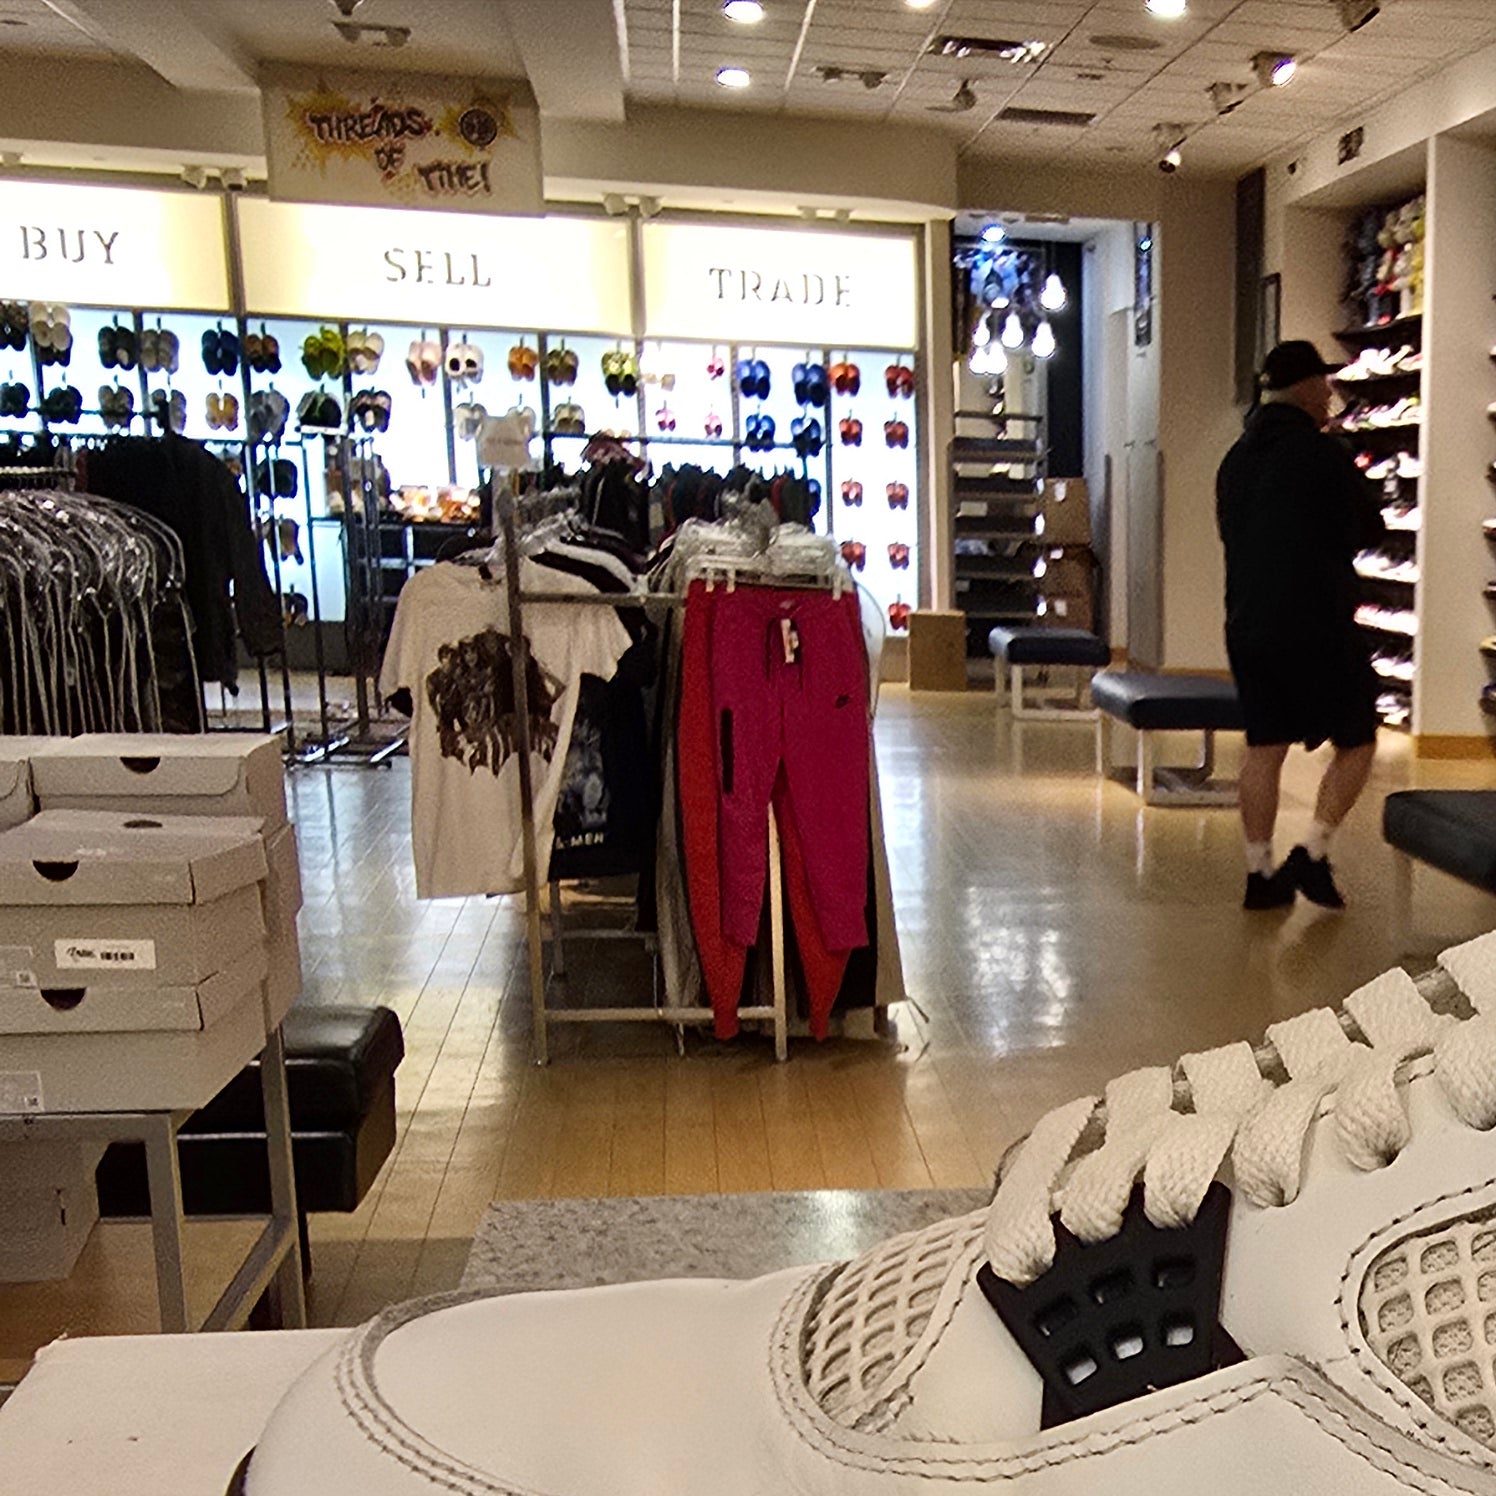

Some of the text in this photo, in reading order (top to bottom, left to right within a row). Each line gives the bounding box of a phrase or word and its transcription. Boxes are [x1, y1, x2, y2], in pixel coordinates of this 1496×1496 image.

[308, 102, 432, 142] THREADS
[20, 226, 119, 264] BUY
[384, 248, 491, 287] SELL
[709, 267, 850, 307] TRADE
